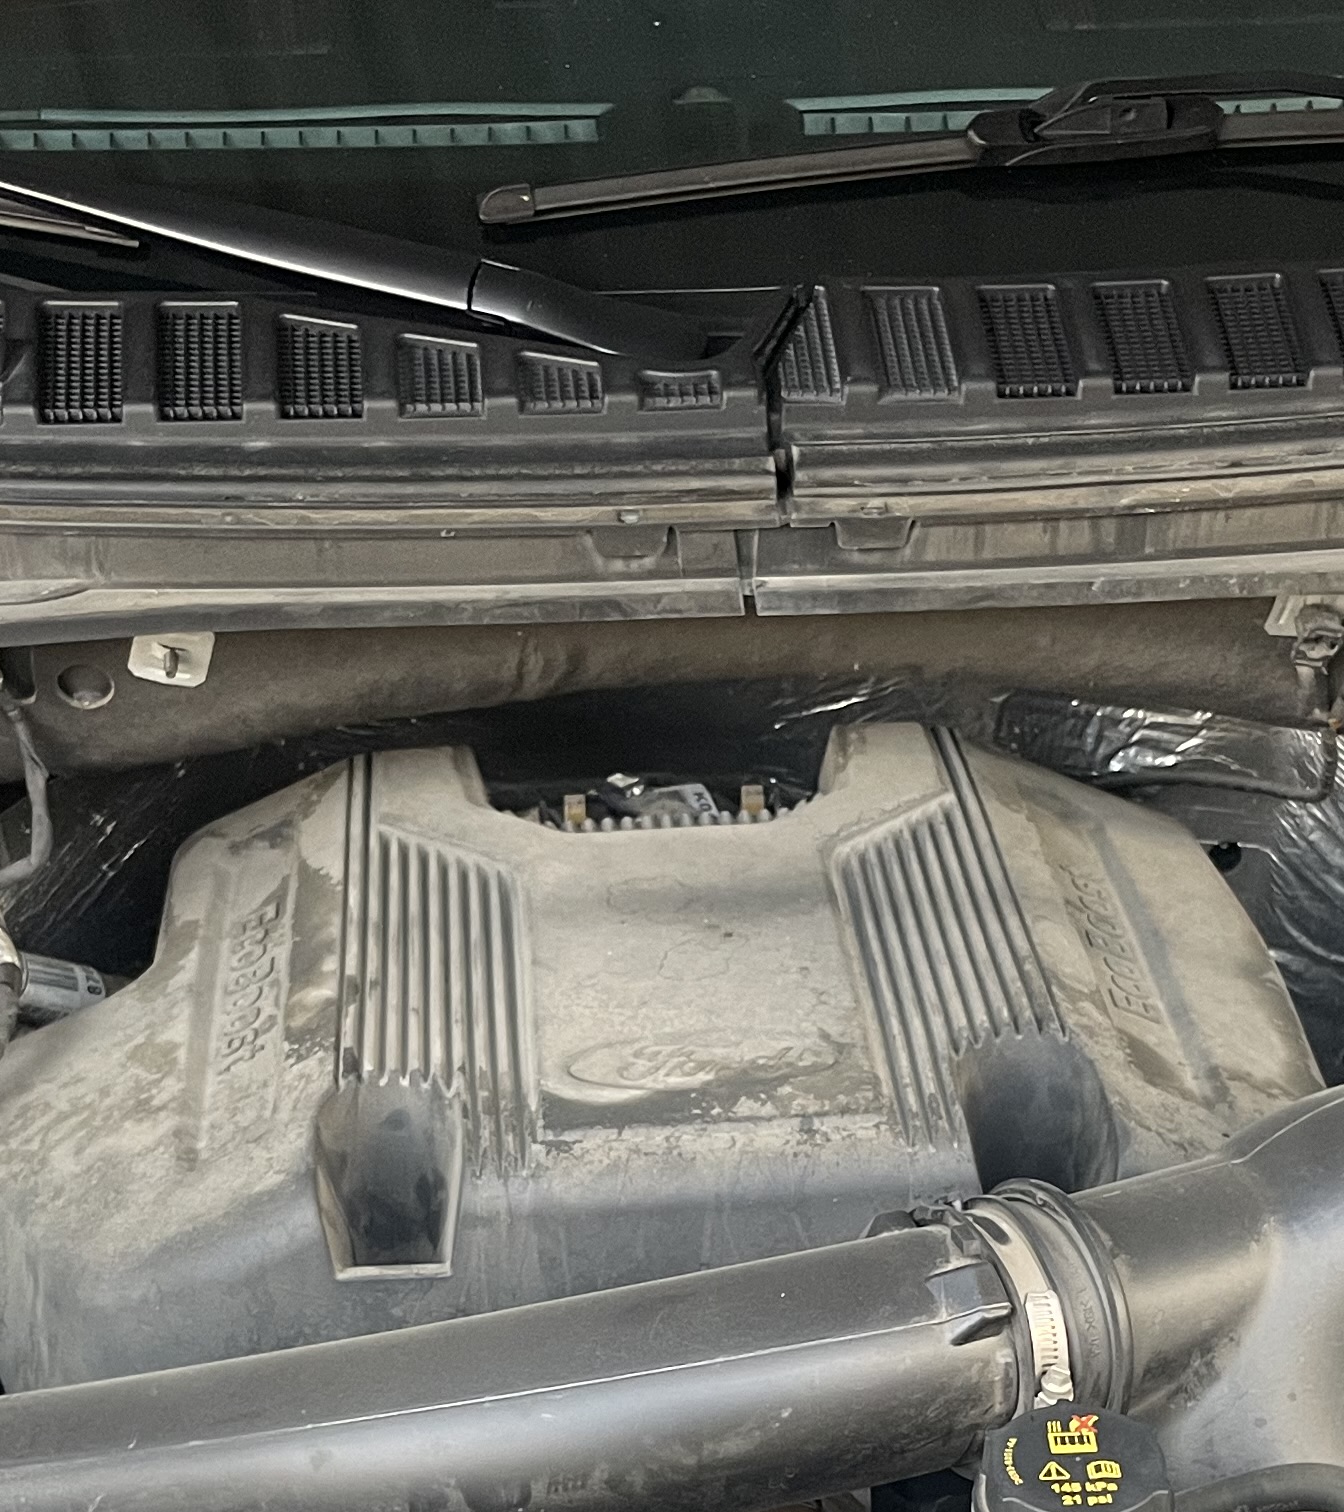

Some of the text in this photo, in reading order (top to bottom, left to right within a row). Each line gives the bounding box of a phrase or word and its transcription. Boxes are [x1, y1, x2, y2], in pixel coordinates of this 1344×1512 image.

[1050, 1481, 1119, 1494] 145 kPa
[1061, 1494, 1113, 1507] 21 psi
